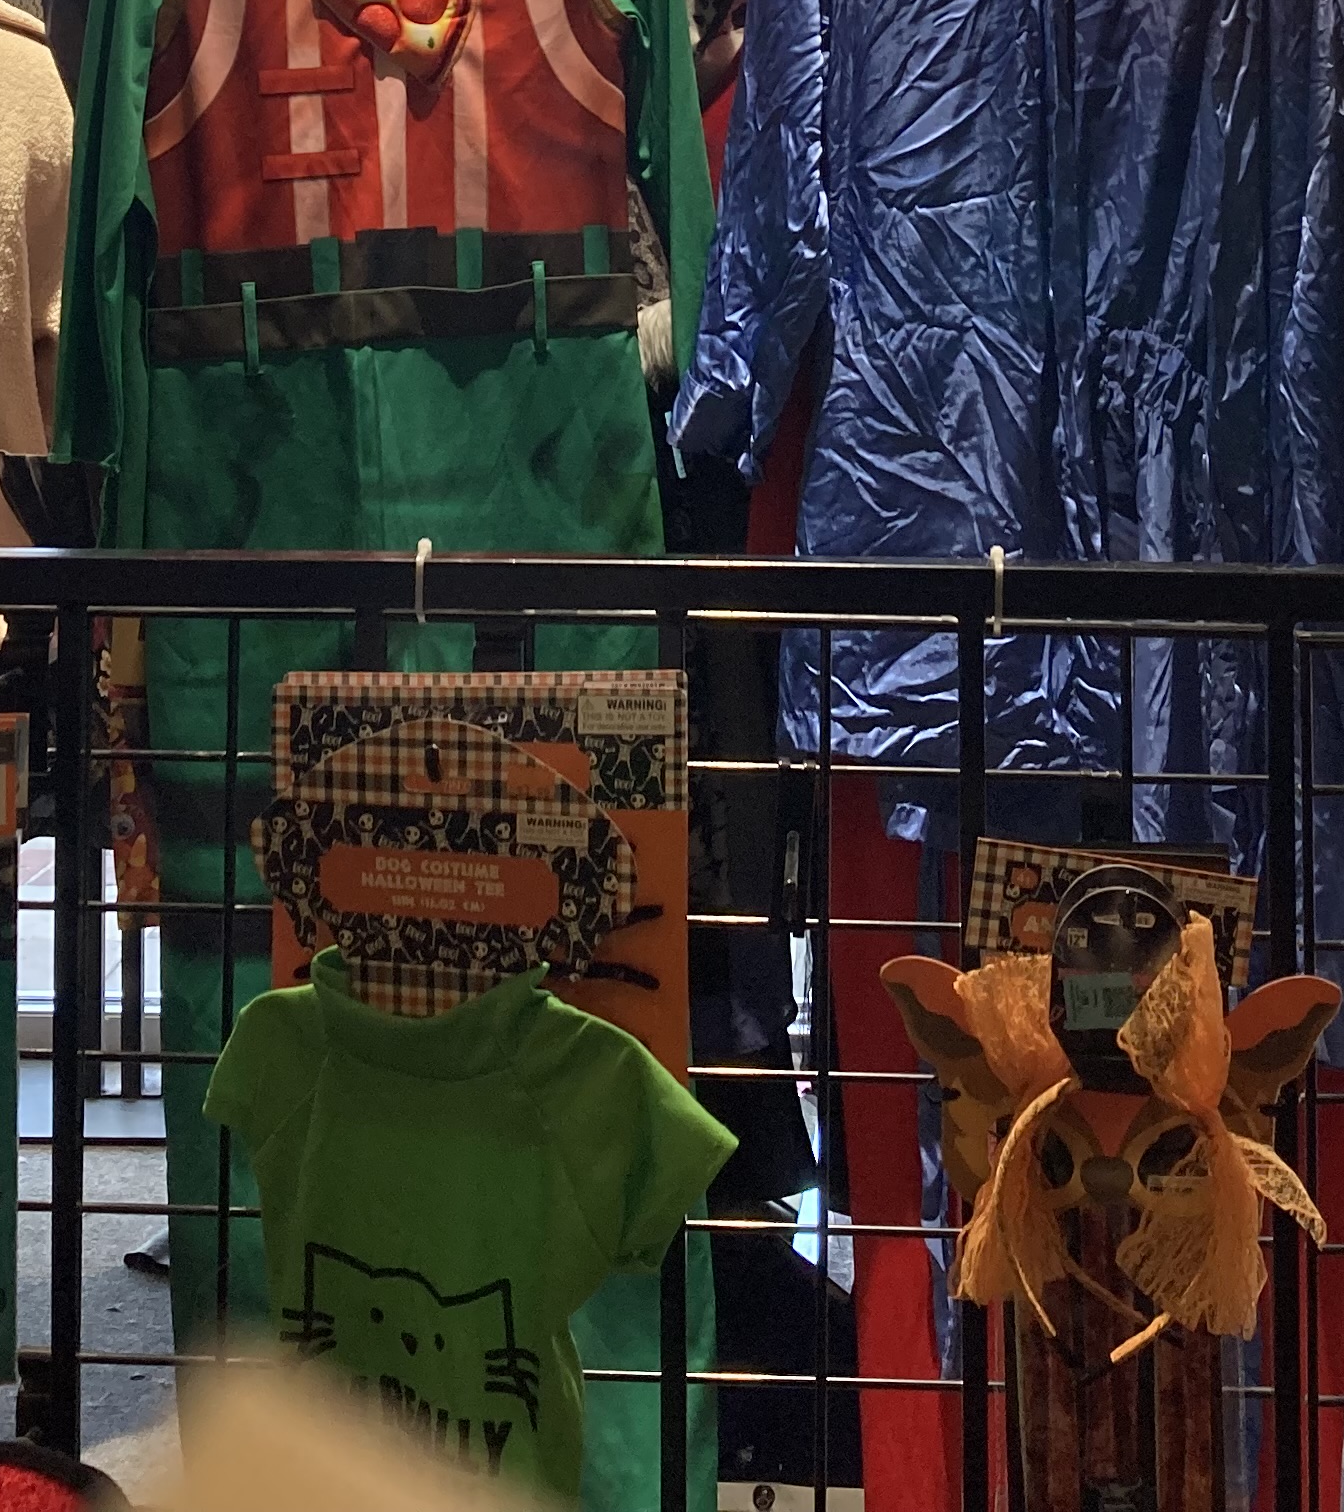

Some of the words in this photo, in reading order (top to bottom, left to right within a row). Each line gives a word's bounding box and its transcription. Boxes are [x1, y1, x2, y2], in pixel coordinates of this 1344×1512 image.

[375, 856, 411, 873] DOG
[420, 859, 499, 879] COSTUME
[361, 872, 465, 893] HALLOWEEN
[474, 881, 505, 897] TEE
